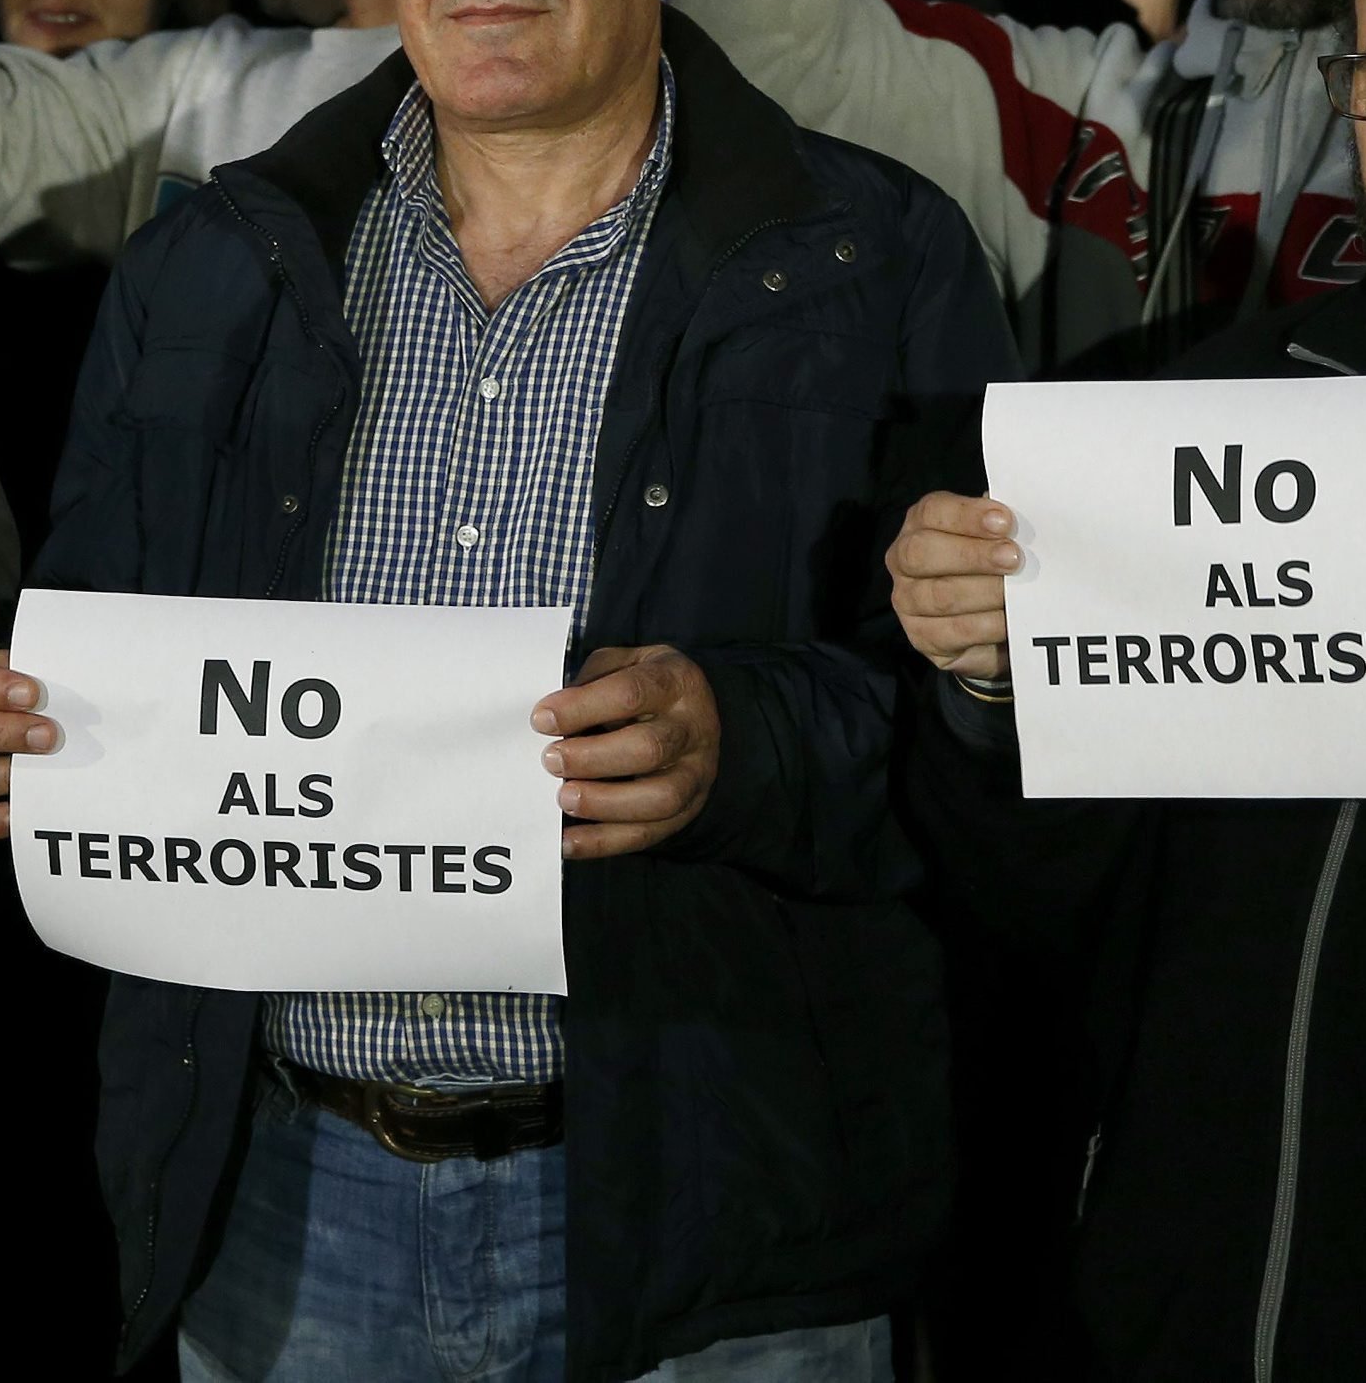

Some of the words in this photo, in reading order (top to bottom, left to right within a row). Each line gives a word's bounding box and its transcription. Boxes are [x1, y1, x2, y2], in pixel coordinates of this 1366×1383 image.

[1173, 444, 1317, 527] No
[1205, 560, 1314, 608] ALS
[199, 659, 342, 740] No
[217, 772, 334, 819] ALS
[33, 830, 513, 895] TERRORISTES
